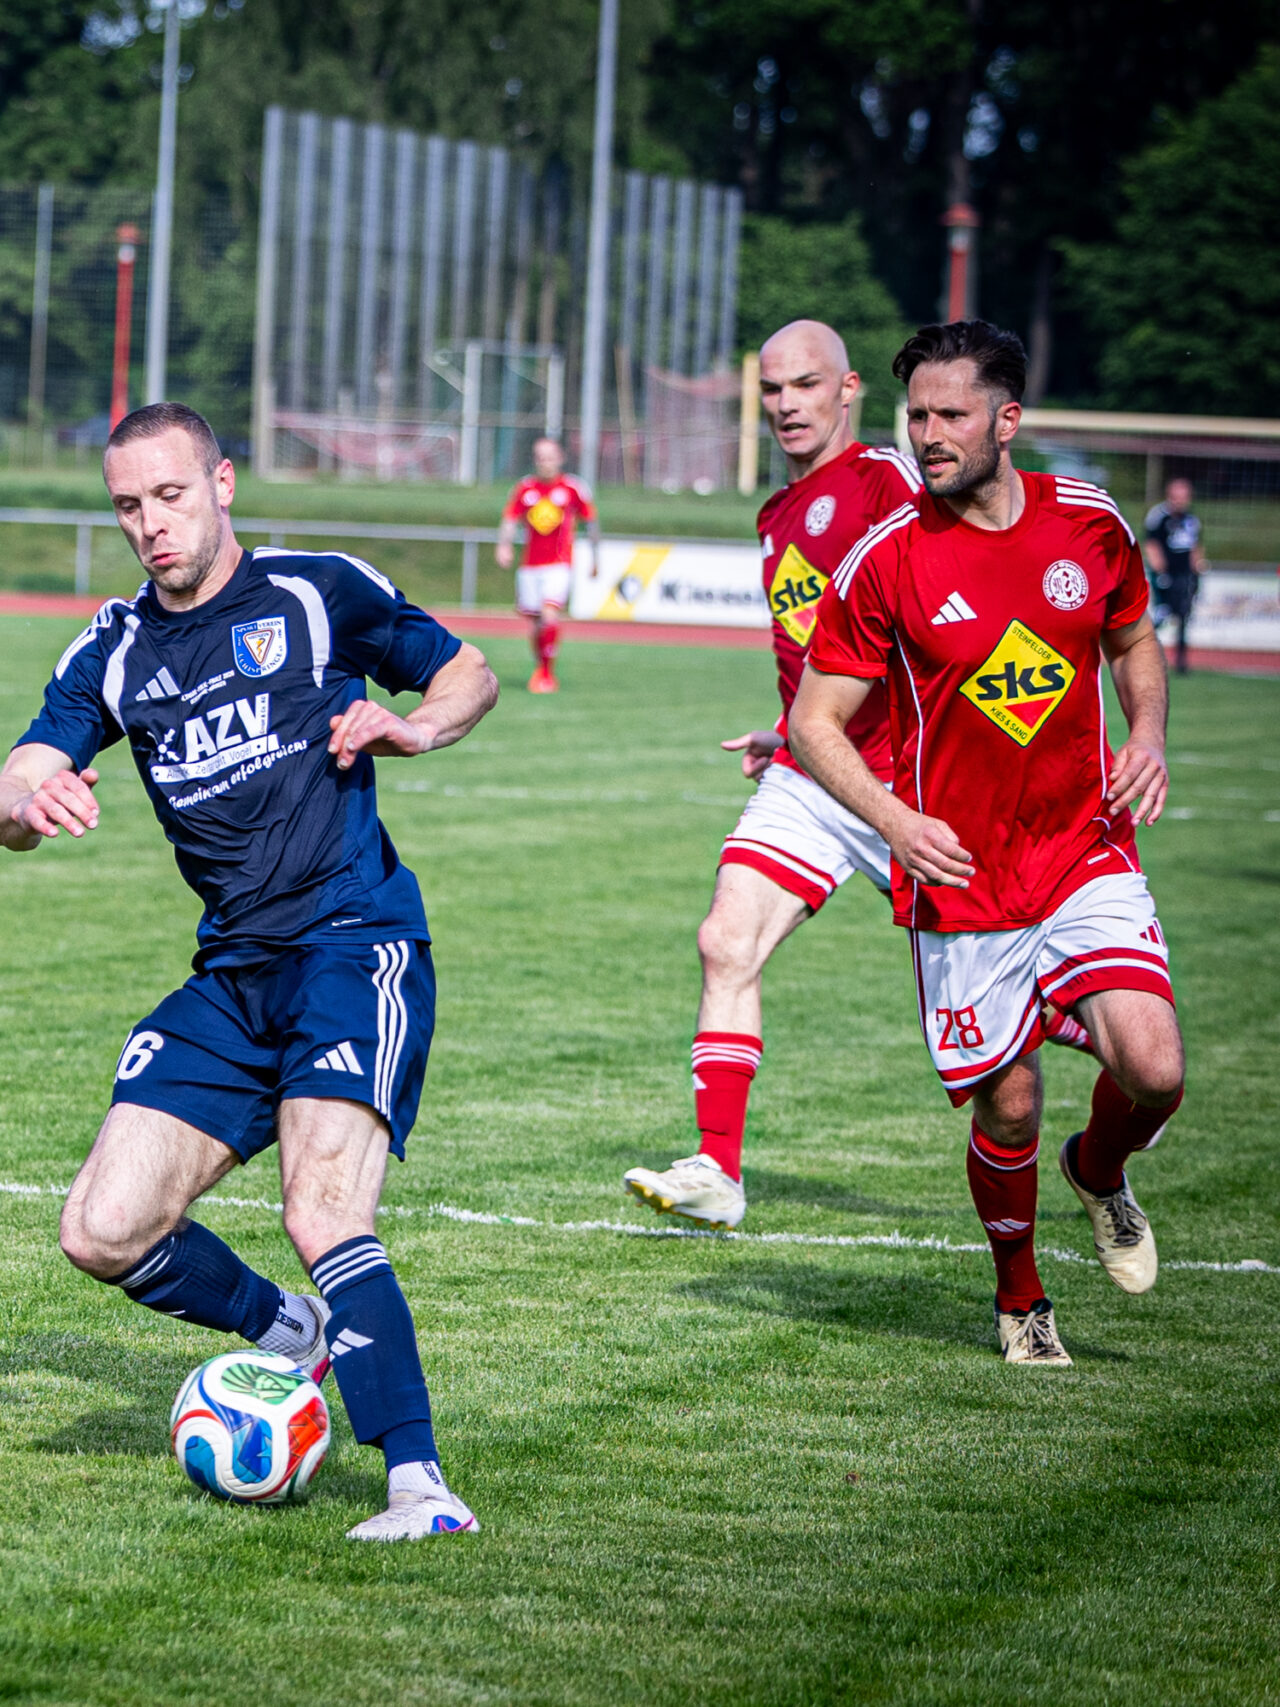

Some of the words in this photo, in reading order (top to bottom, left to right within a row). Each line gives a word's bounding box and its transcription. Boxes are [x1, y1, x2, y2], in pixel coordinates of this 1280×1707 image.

[1011, 626, 1052, 661] STEINFELDER
[184, 692, 270, 764] AZV
[990, 706, 1007, 722] KIES
[1009, 723, 1028, 740] SAND
[935, 1004, 985, 1051] 28
[113, 1028, 164, 1083] 6
